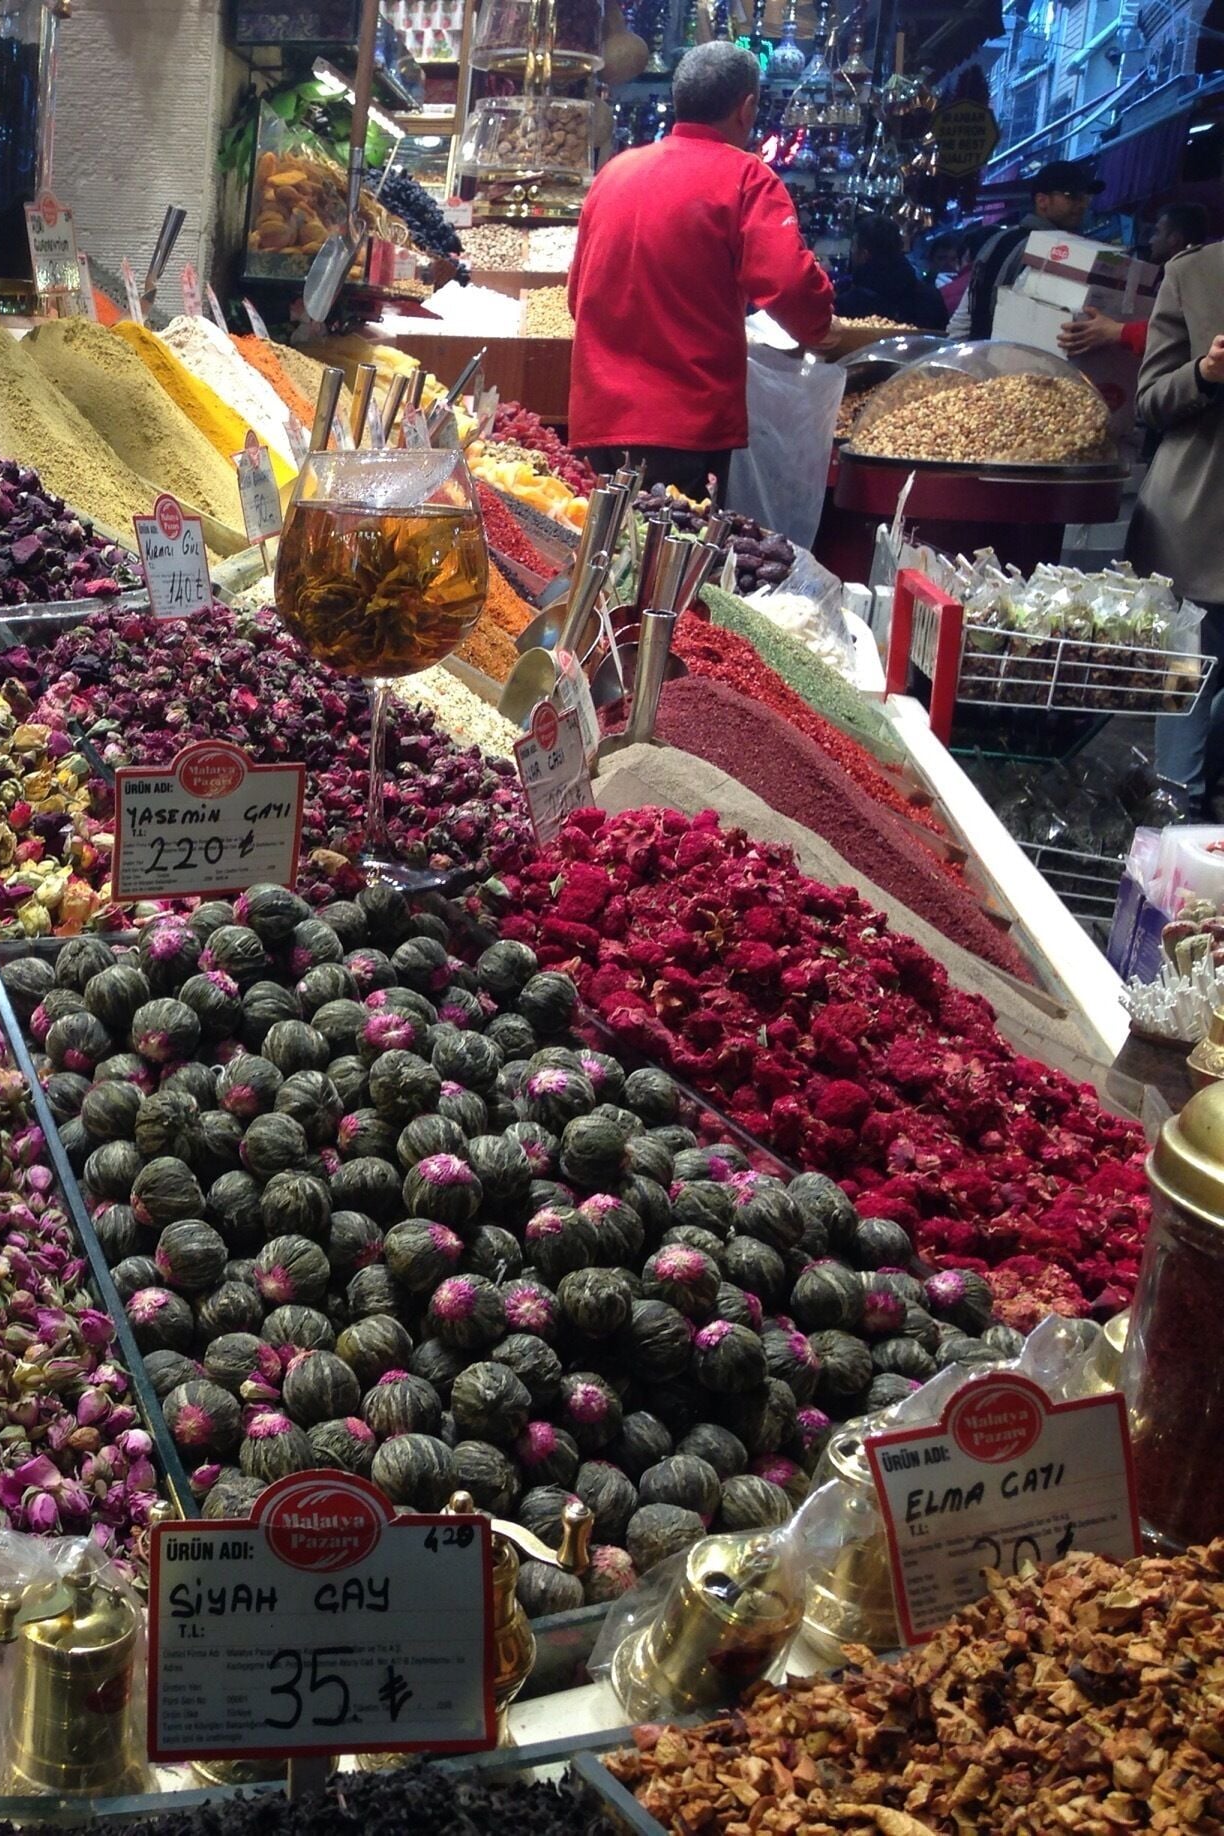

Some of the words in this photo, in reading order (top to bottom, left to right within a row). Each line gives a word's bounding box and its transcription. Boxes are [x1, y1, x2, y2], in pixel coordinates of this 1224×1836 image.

[125, 781, 150, 795] ÜRÜN
[154, 783, 173, 793] ADI:
[127, 804, 220, 829] YASEMİN
[145, 836, 224, 874] 220
[963, 1410, 1028, 1429] Malatya
[882, 1449, 920, 1473] ÜRÜN
[923, 1446, 951, 1464] ADI:
[905, 1481, 985, 1523] ELMA
[281, 1513, 366, 1532] Malatya
[167, 1538, 214, 1562] ÜRÜN
[219, 1540, 255, 1561] ADI:
[291, 1534, 359, 1550] Pazarı
[169, 1578, 277, 1618] SİYAH
